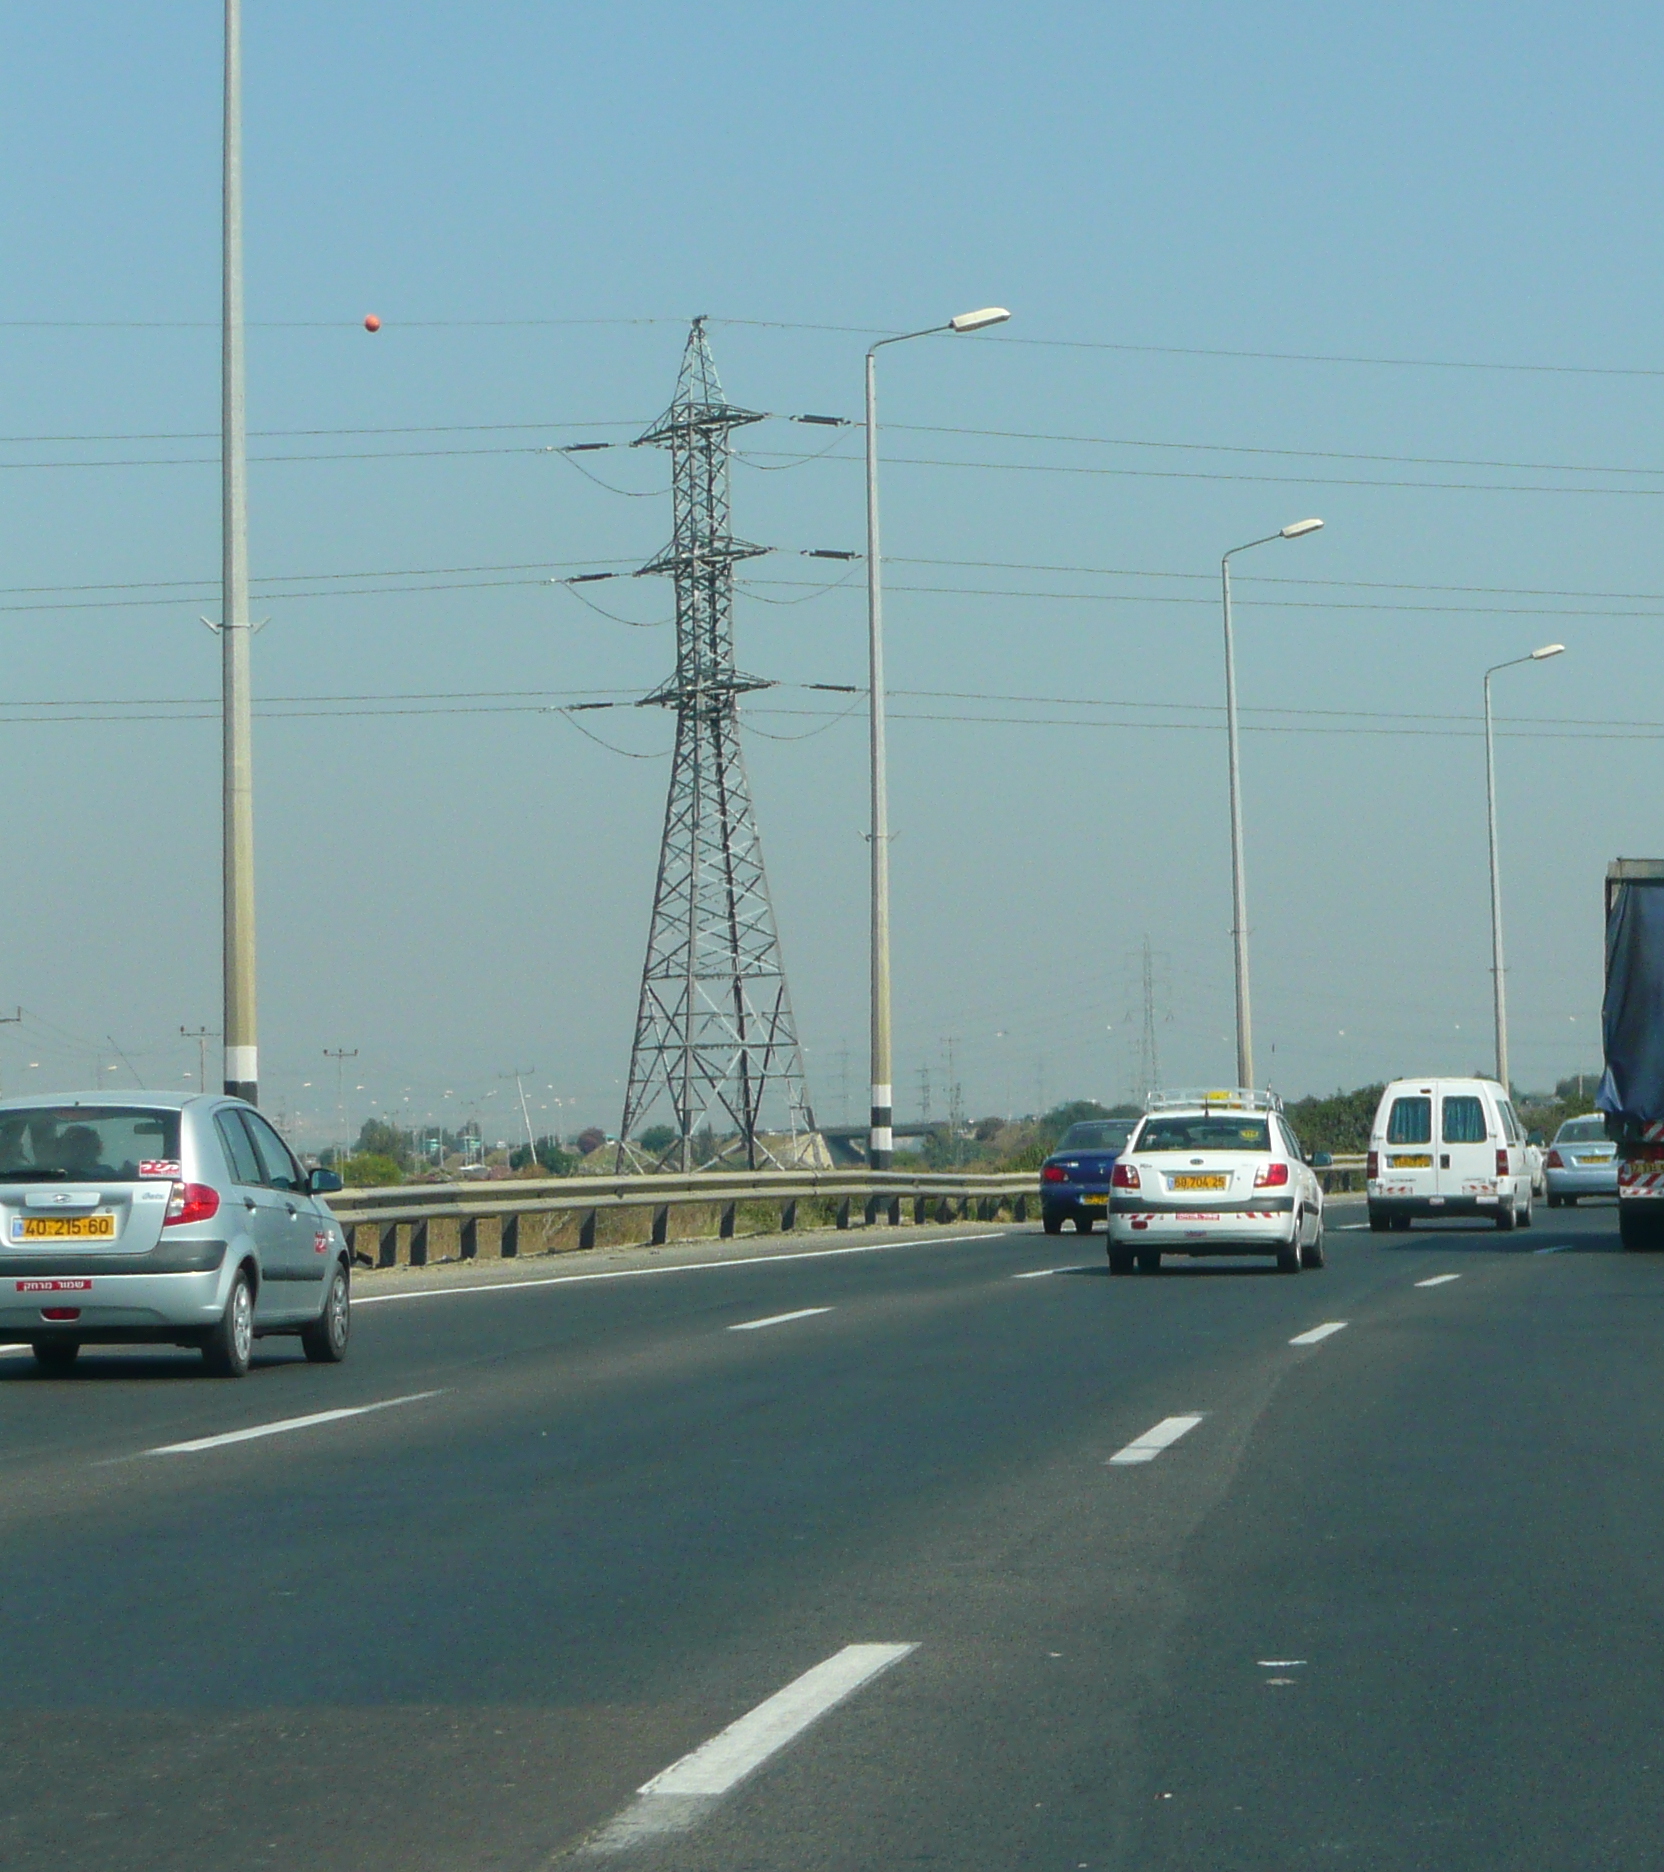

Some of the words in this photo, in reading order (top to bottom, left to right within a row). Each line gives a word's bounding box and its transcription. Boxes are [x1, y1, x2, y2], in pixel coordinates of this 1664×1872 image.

[25, 1219, 47, 1236] 40
[54, 1218, 82, 1235] 215
[88, 1218, 110, 1235] 60
[23, 1282, 53, 1292] מרחק
[57, 1281, 84, 1290] שמור
